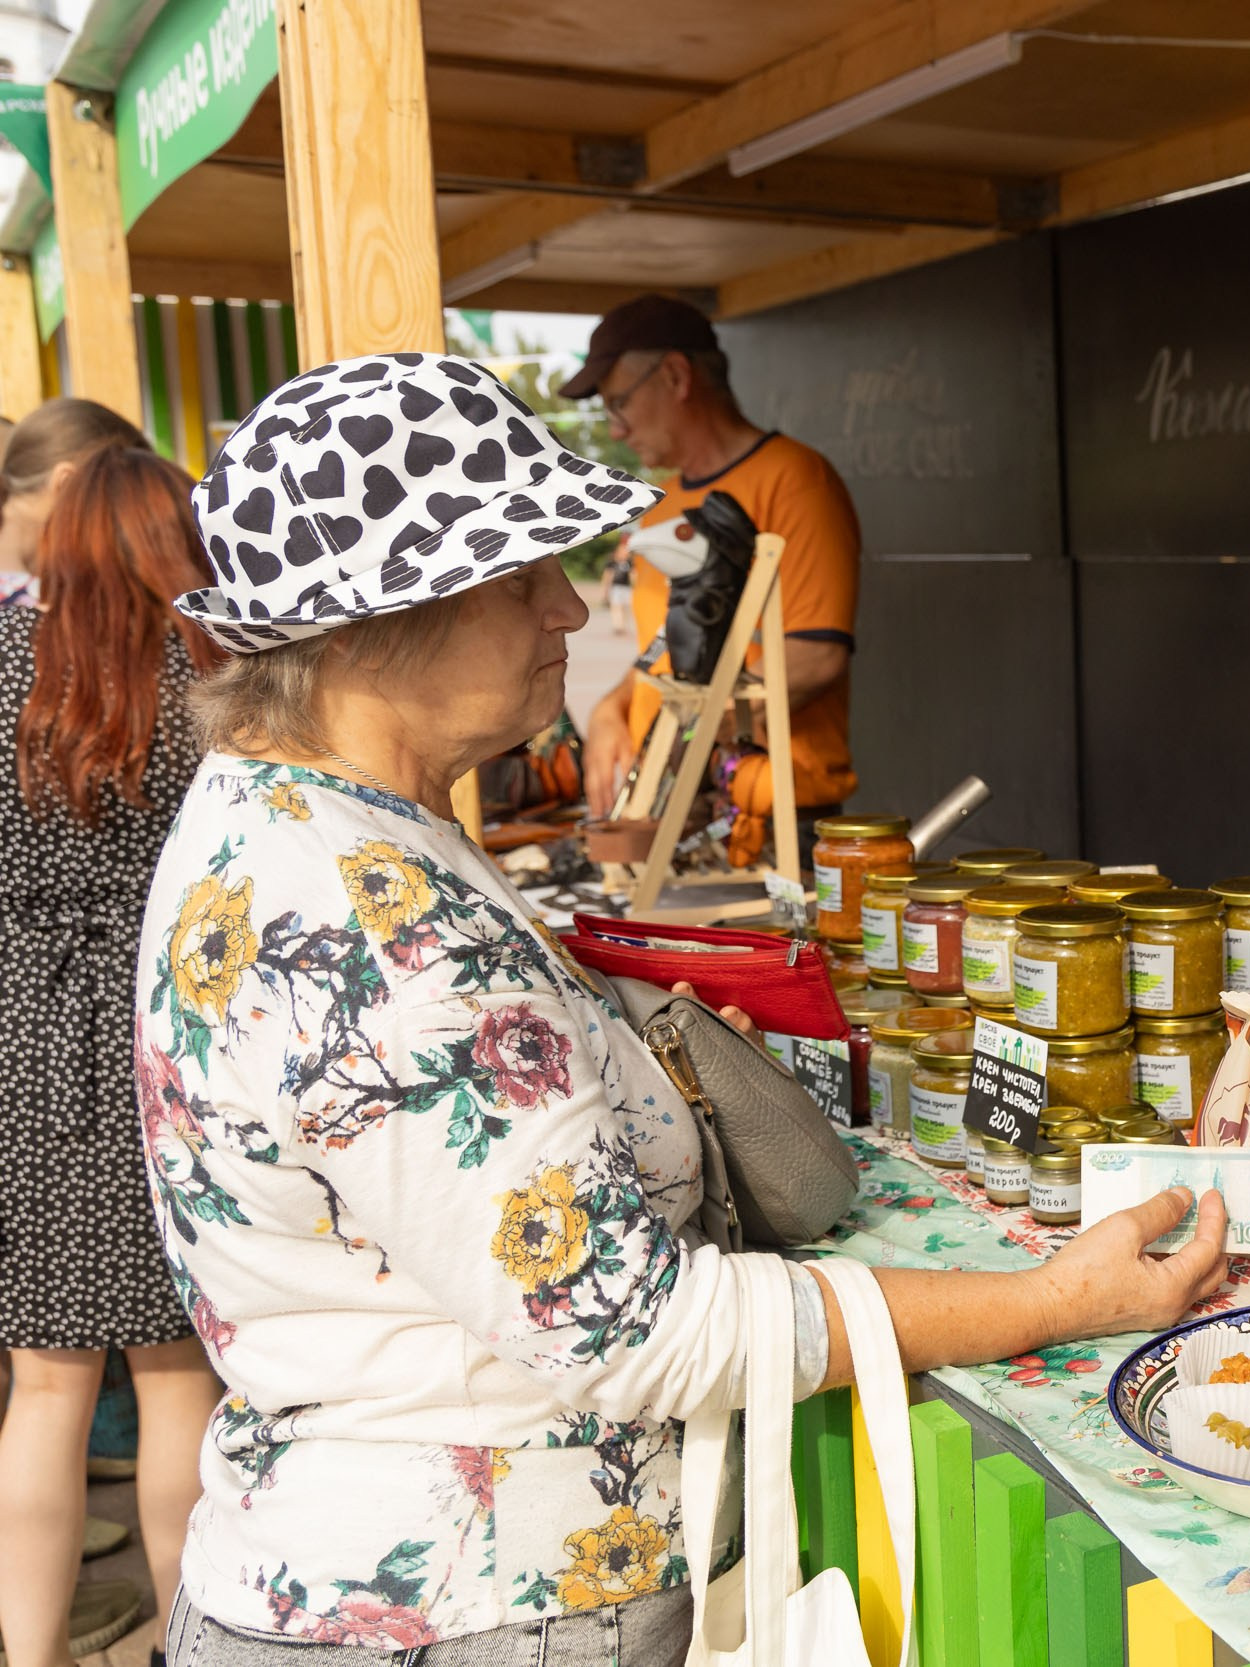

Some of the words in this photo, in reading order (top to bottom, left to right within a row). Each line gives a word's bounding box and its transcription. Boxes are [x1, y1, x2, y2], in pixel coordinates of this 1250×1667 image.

[136, 41, 209, 178] Ручные
[796, 1054, 803, 1069] К
[1150, 1063, 1176, 1072] продукт
[1002, 1067, 1041, 1099] ЧИСТОТЕЛ
[932, 1101, 957, 1111] продукт
[1095, 1152, 1125, 1165] 1000
[996, 1168, 1021, 1180] продукт
[1032, 1185, 1053, 1196] продукт
